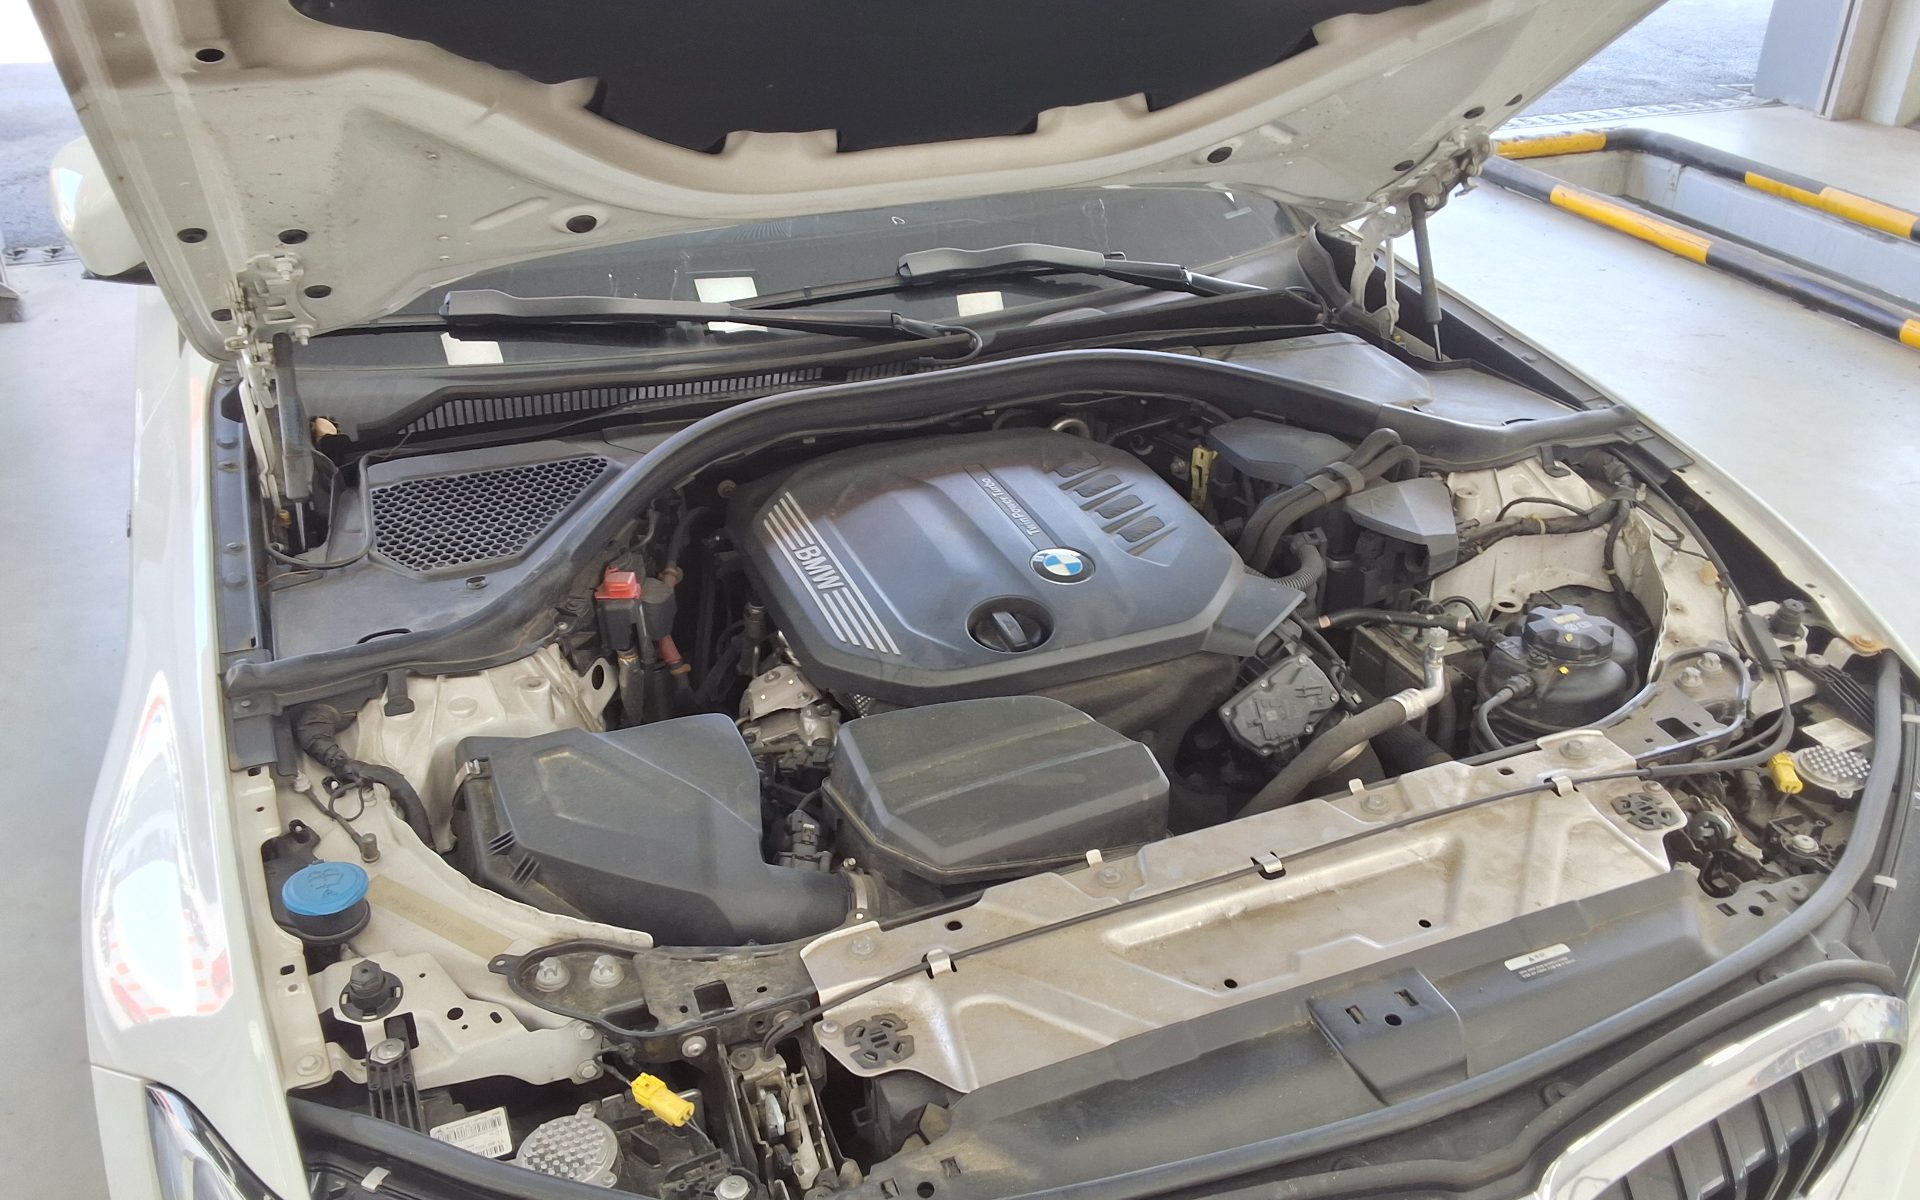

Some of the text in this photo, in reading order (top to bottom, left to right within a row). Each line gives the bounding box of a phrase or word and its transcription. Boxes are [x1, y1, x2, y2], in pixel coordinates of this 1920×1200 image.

[981, 477, 1041, 537] TwinPower Turbo
[794, 545, 845, 591] BMW
